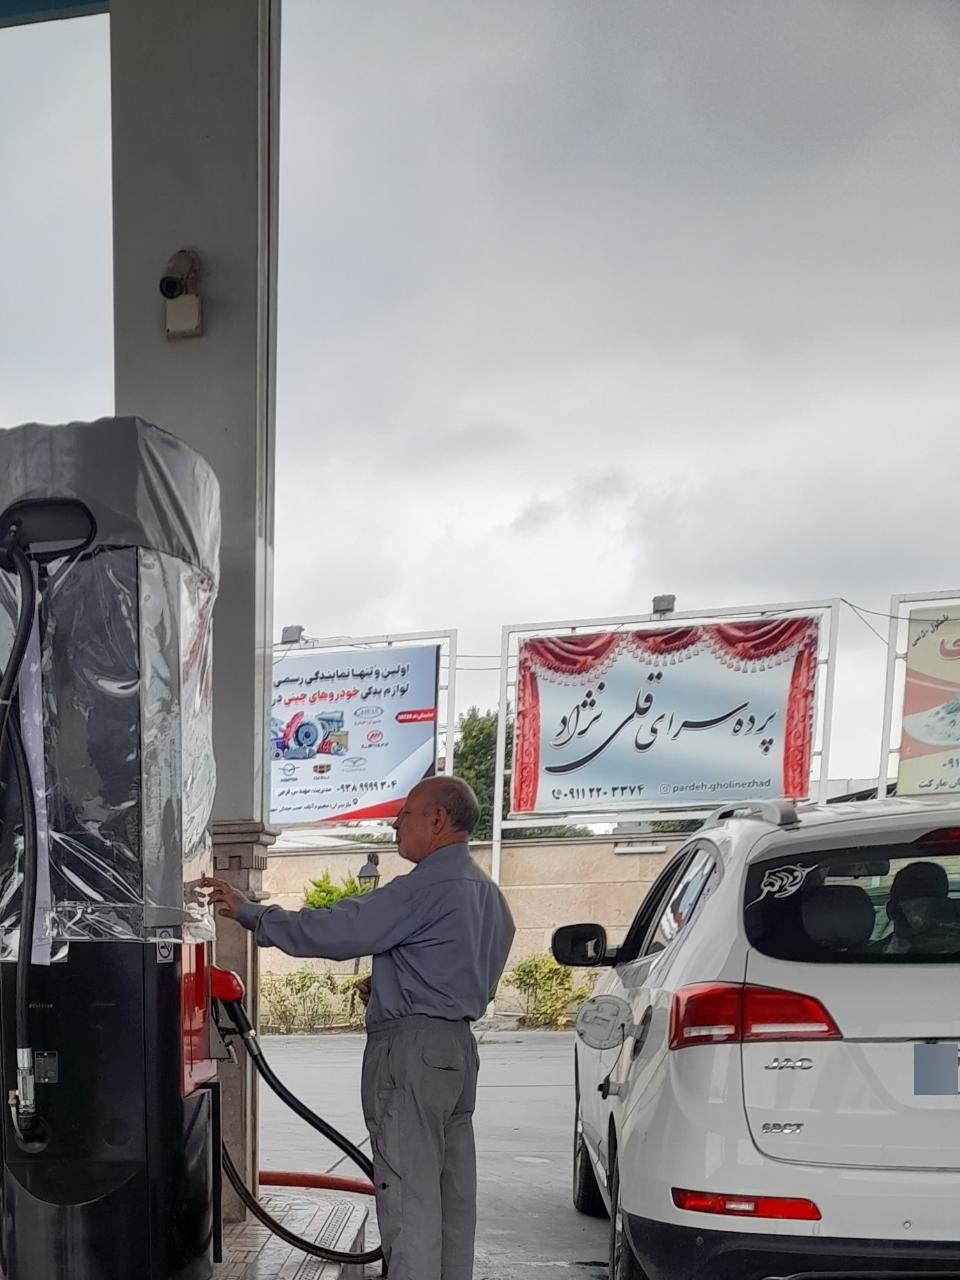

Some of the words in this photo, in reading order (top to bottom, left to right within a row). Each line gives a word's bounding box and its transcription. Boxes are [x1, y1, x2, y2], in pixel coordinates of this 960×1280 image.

[305, 668, 350, 685] نمایندگی
[351, 666, 373, 680] تنها
[381, 663, 410, 678] اولین
[273, 676, 304, 688] رسمی
[360, 685, 382, 700] یدکی
[383, 683, 409, 697] لوازم
[550, 680, 607, 748] نژاد
[731, 711, 777, 753] پرده
[672, 779, 771, 793] pardeh.gholinezhad
[763, 1057, 815, 1070] JAC
